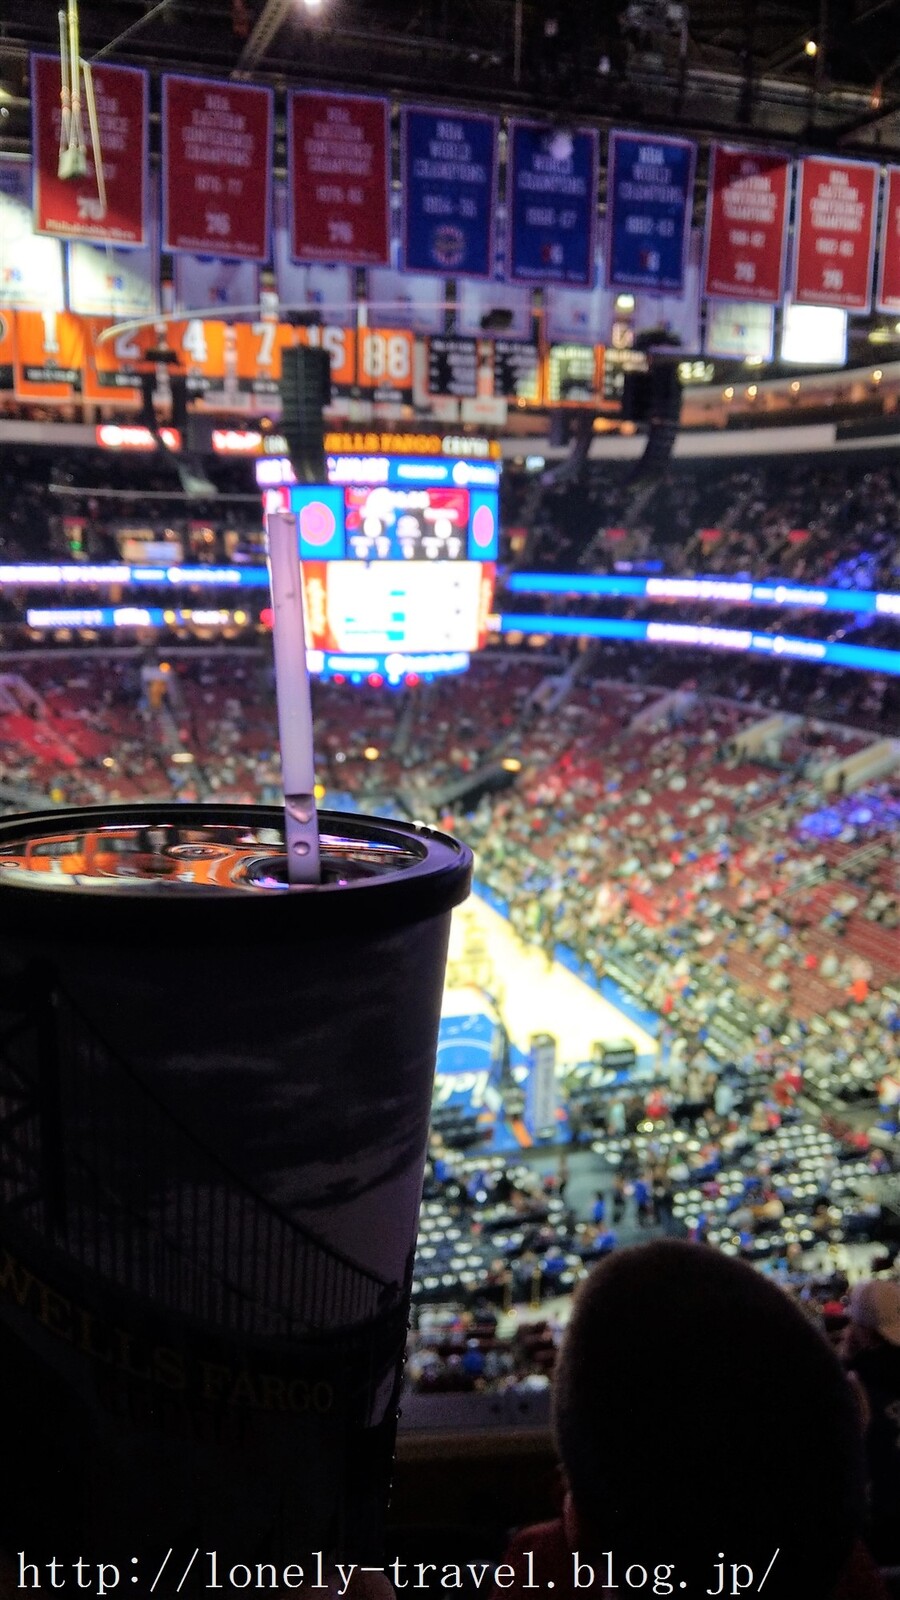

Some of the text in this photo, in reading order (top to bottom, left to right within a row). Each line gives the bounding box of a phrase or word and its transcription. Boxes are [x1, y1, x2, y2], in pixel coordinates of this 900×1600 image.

[182, 319, 207, 362] 4
[252, 322, 277, 366] 7
[363, 334, 411, 380] 88
